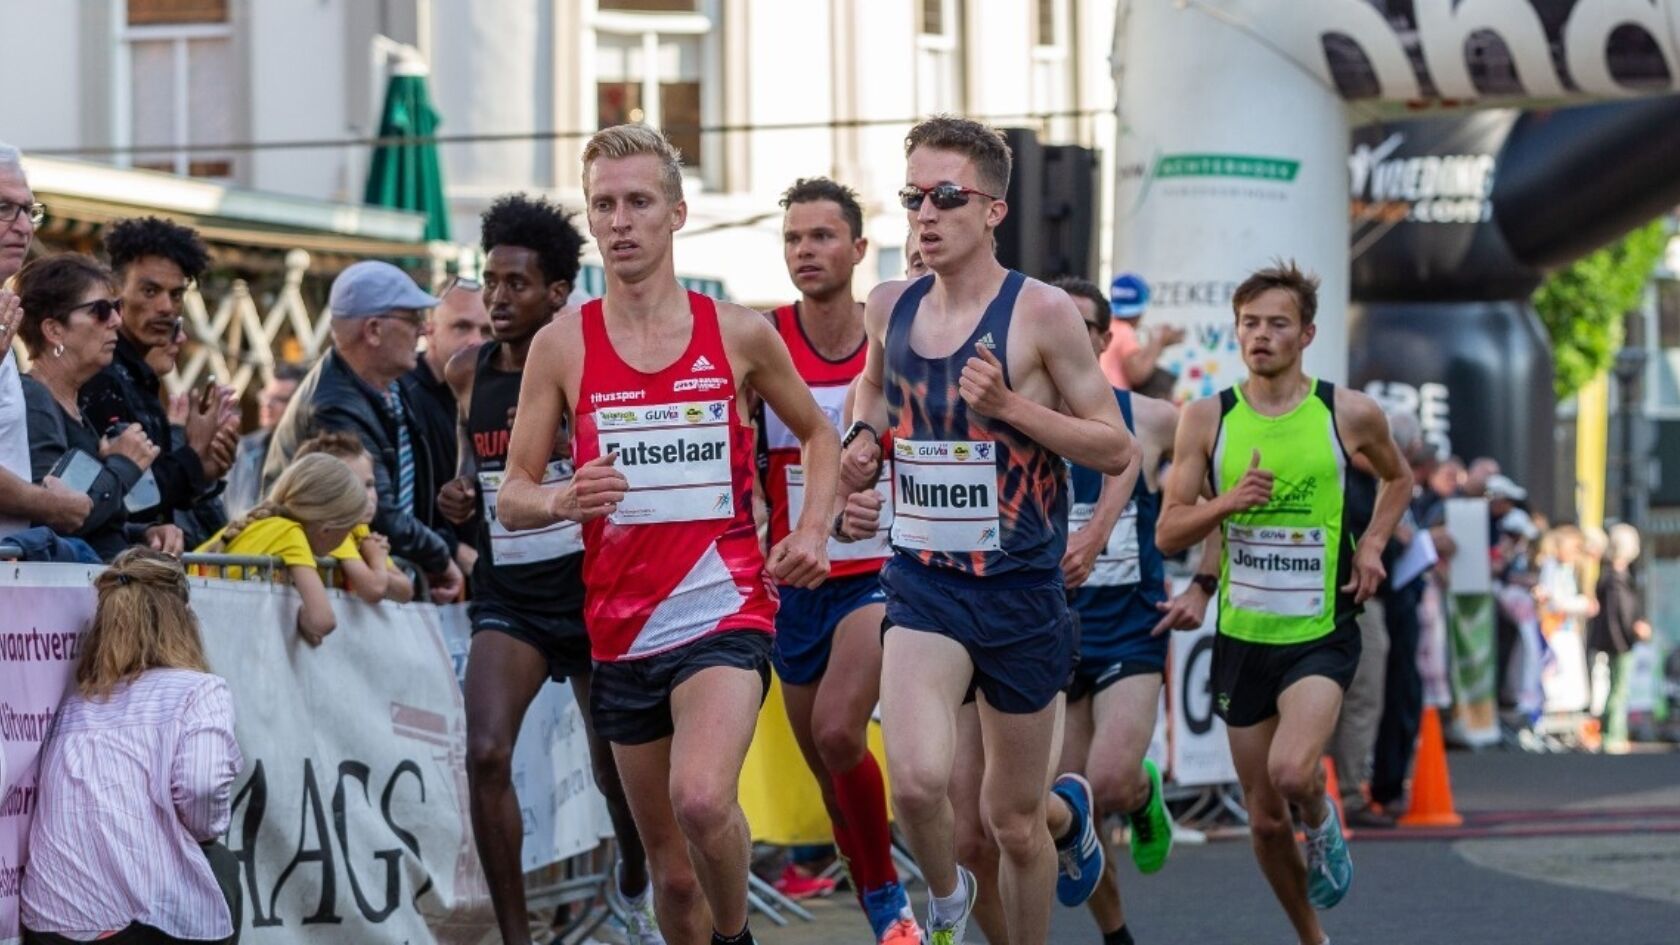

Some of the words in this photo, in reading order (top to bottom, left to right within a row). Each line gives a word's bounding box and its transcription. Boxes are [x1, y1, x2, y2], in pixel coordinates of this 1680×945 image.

[591, 389, 646, 403] titussport
[606, 438, 726, 466] Futselaar
[900, 474, 989, 508] Nunen
[1233, 549, 1320, 571] Jorritsma
